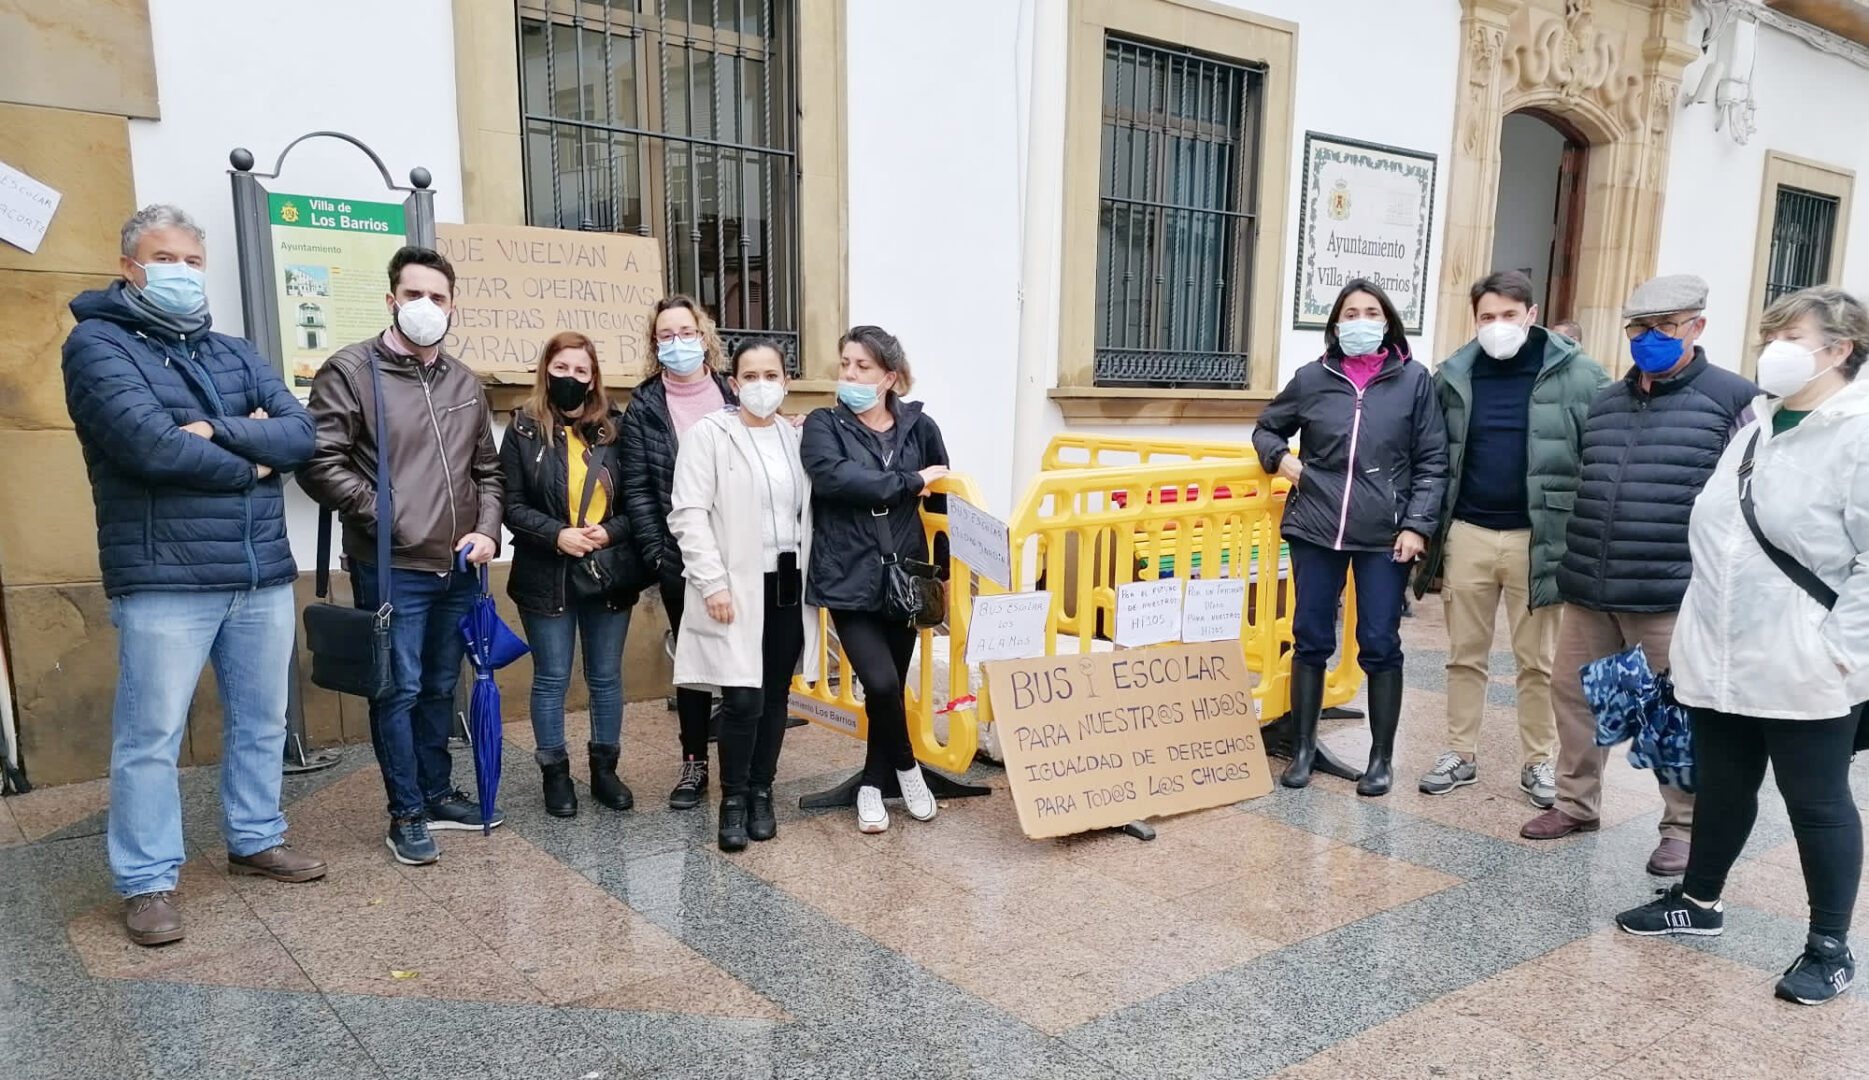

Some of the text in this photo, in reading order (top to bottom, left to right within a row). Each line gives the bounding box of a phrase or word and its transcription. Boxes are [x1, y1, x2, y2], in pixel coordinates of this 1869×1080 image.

[309, 199, 351, 213] Villa de
[311, 213, 389, 231] Los Barrios
[281, 242, 342, 254] Ayuntamiento
[497, 240, 607, 267] VUELVAN
[624, 250, 639, 272] A
[1326, 230, 1405, 259] Ayuntamiento
[523, 277, 656, 307] OPERATIVAS
[1318, 267, 1343, 287] Villa
[1374, 272, 1410, 292] Barrios
[556, 309, 647, 334] ANTIGUAS
[1010, 656, 1231, 710] BUS ESCOLAR
[815, 706, 828, 718] Los
[830, 711, 856, 728] Barrios
[1014, 691, 1249, 751] PARA NUESTR@S HIJ@S
[1024, 735, 1256, 782] IGUALDAD DE DERECHOS
[1034, 762, 1250, 818] PARA TOD@S L@S CHIC@S
